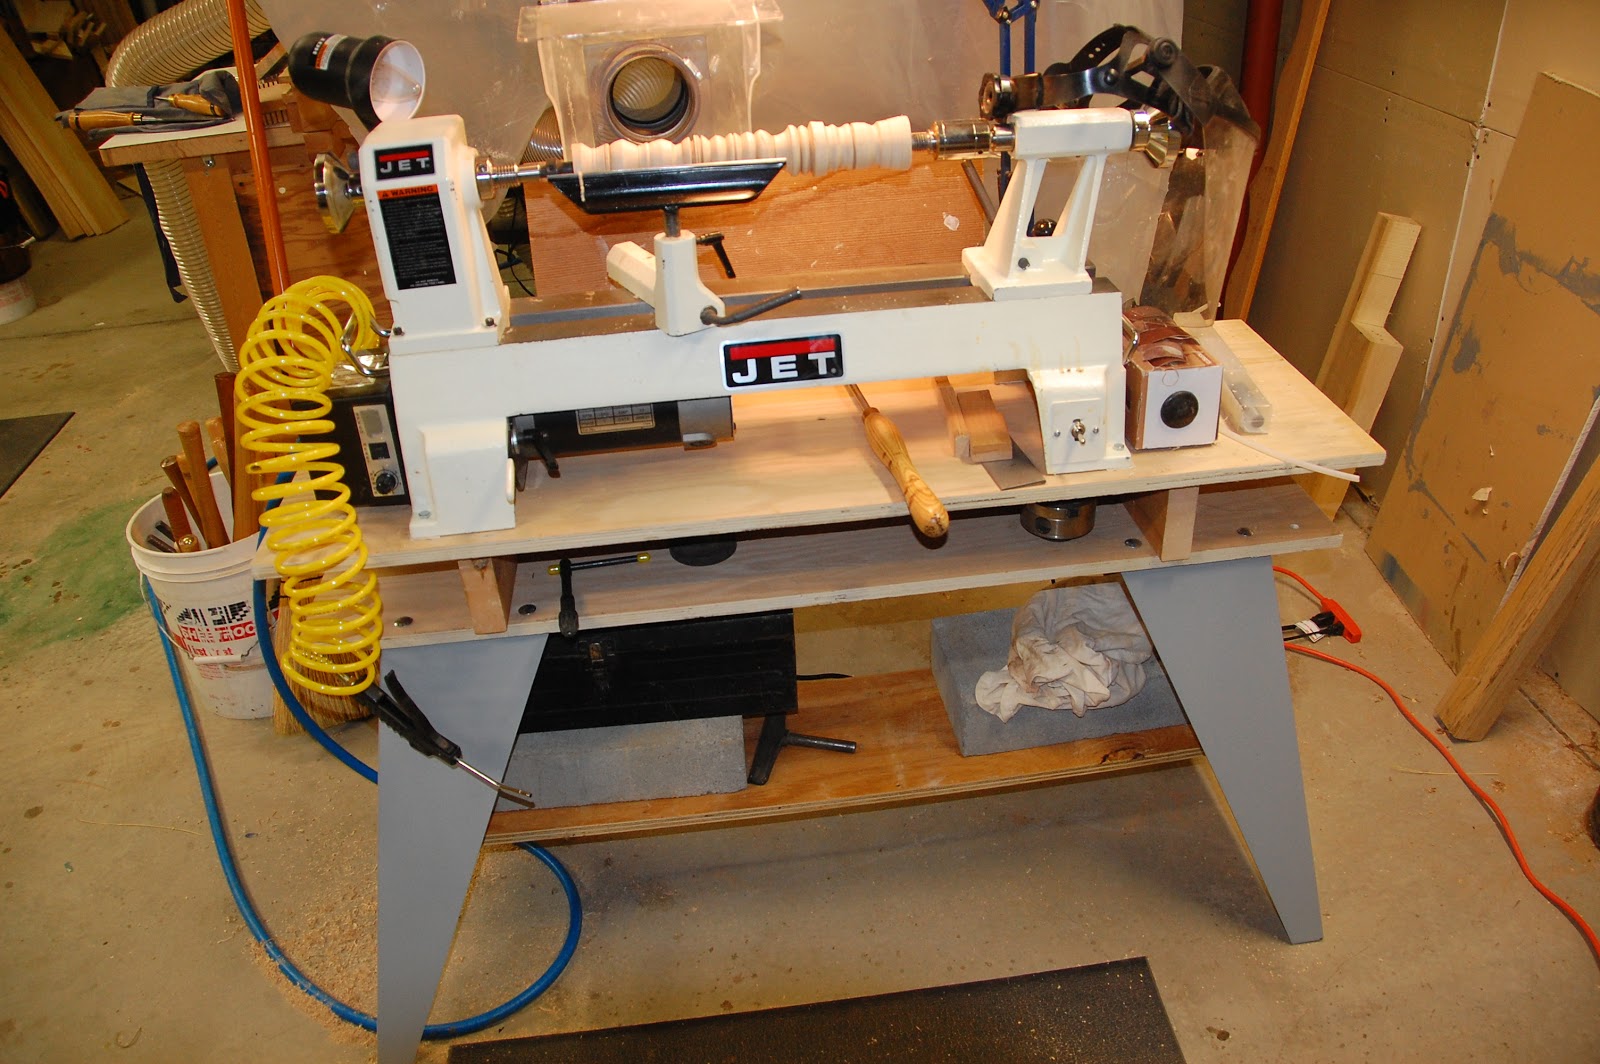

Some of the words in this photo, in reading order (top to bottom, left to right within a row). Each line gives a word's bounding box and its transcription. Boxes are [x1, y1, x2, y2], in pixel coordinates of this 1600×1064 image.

[380, 157, 430, 173] JET
[391, 185, 433, 196] WARNING
[732, 351, 836, 384] JET
